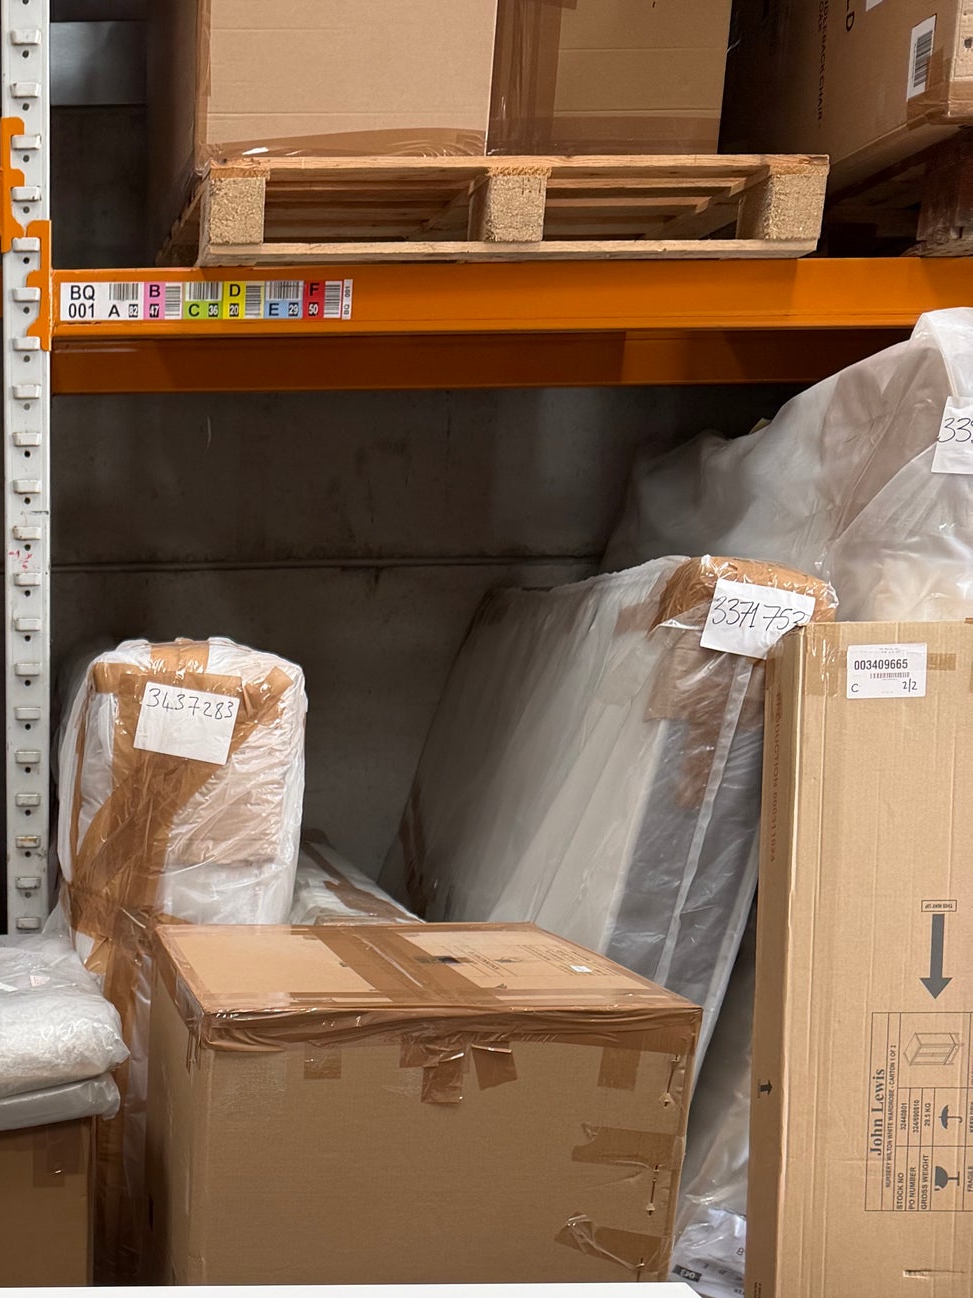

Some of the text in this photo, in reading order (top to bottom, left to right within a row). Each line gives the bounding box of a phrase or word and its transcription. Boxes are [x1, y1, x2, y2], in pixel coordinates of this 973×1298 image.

[70, 285, 95, 301] BQ
[149, 285, 160, 297] B
[229, 284, 240, 297] D
[309, 283, 319, 296] F
[68, 303, 95, 318] 001
[108, 304, 120, 317] A
[149, 304, 159, 318] 47
[189, 304, 200, 317] C
[269, 303, 279, 316] E
[938, 417, 973, 443] 33
[854, 659, 908, 670] 003409665
[146, 688, 234, 719] 3437283
[869, 1068, 885, 1156] John Lewis
[898, 1173, 904, 1184] NO
[908, 1199, 915, 1209] PO
